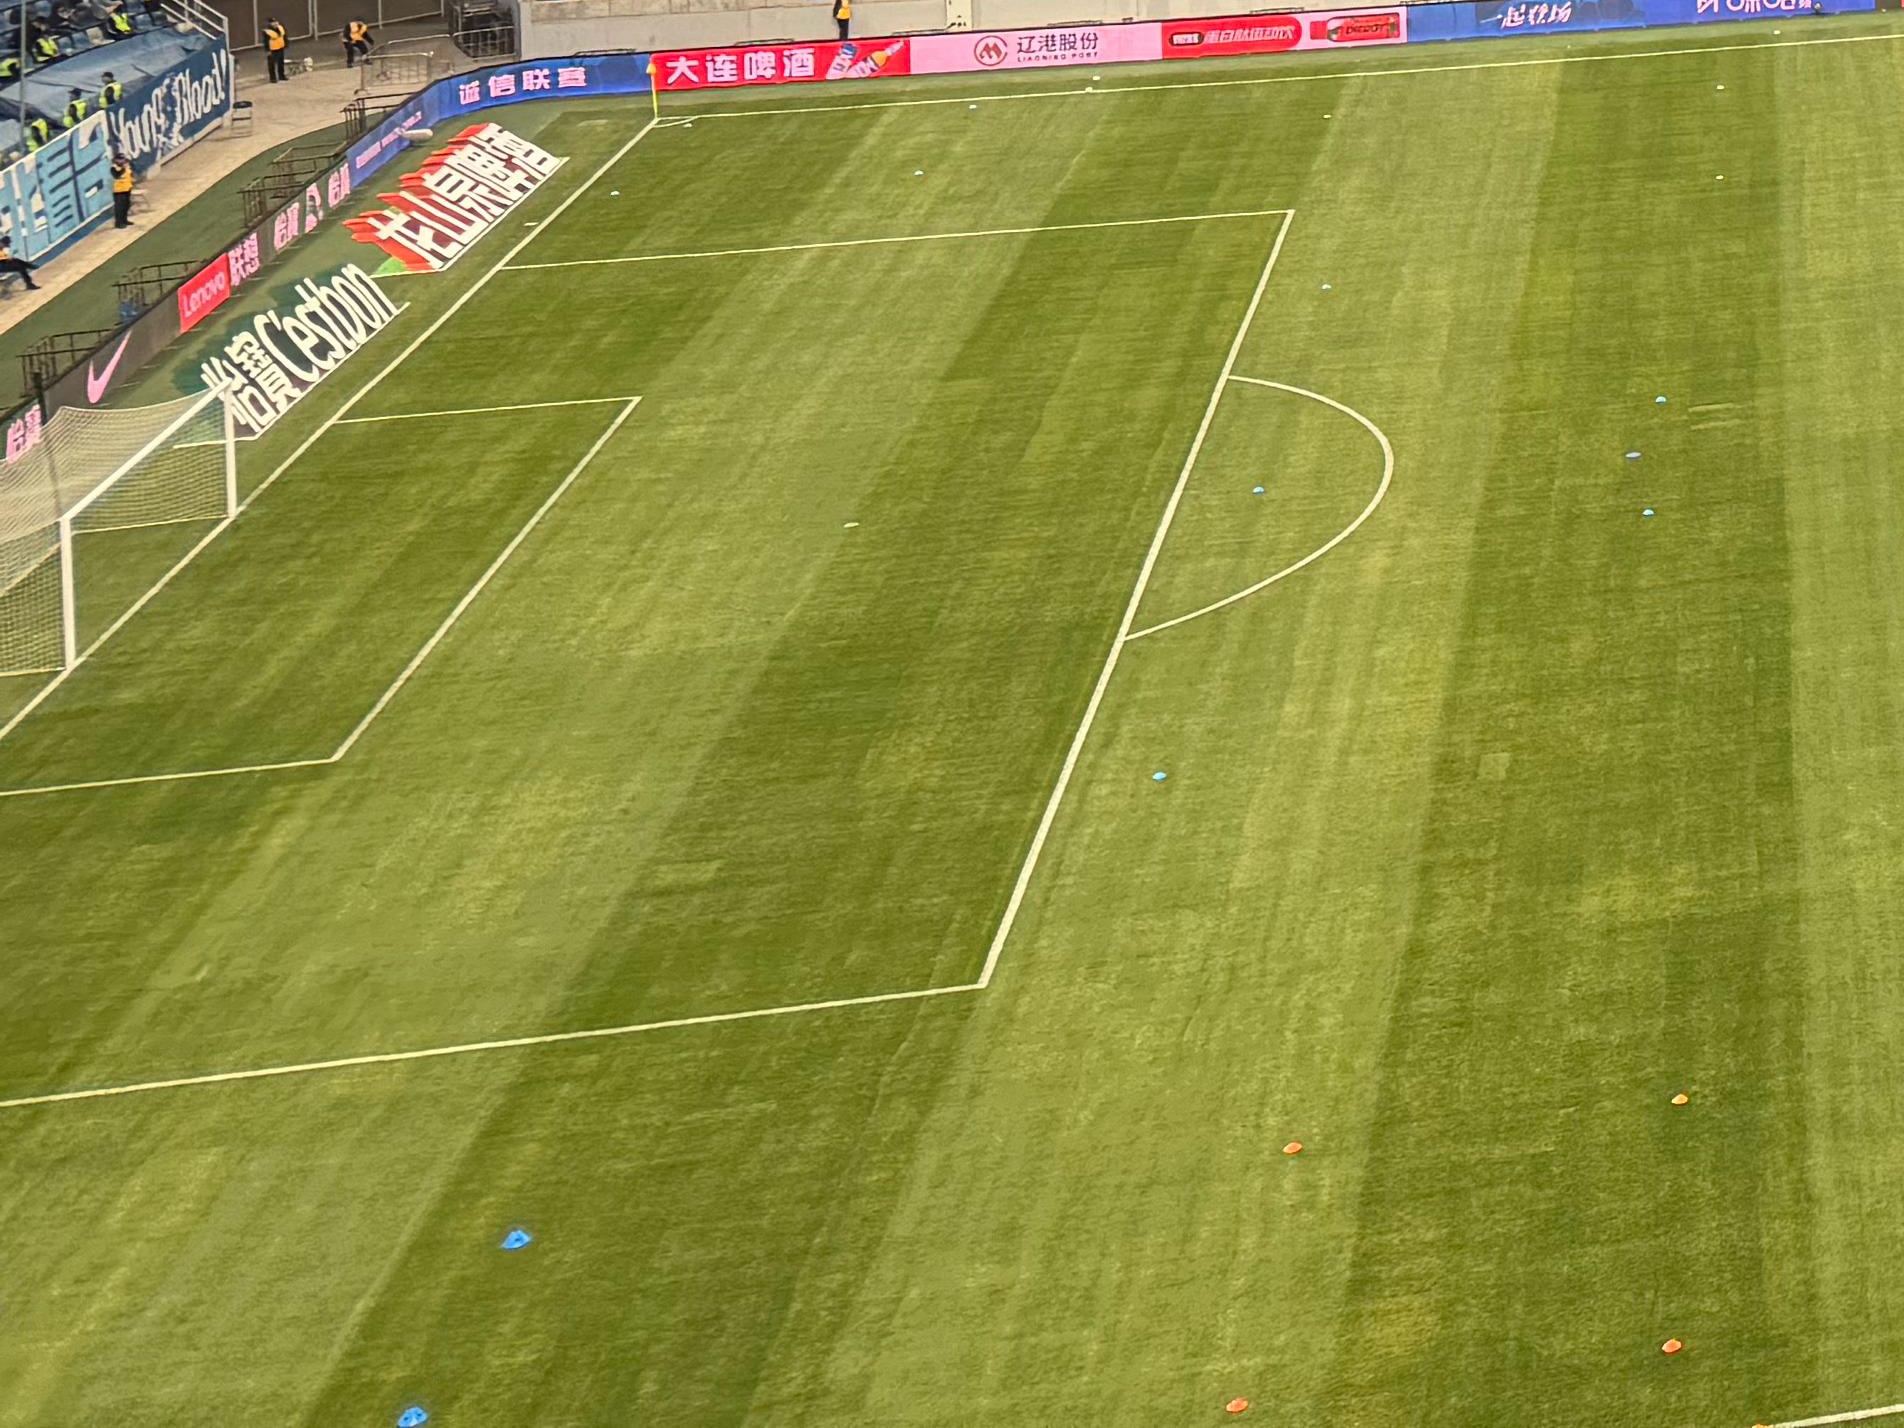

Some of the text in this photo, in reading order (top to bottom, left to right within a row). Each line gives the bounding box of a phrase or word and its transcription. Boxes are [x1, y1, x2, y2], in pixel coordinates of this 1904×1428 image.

[666, 45, 817, 86] 大连啤酒
[1017, 32, 1099, 55] 辽港股份
[174, 48, 228, 126] Blood!
[459, 65, 587, 105] 诚信联赛
[228, 231, 261, 287] 联想
[182, 268, 227, 320] Lenovo
[253, 261, 400, 386] C'estbon
